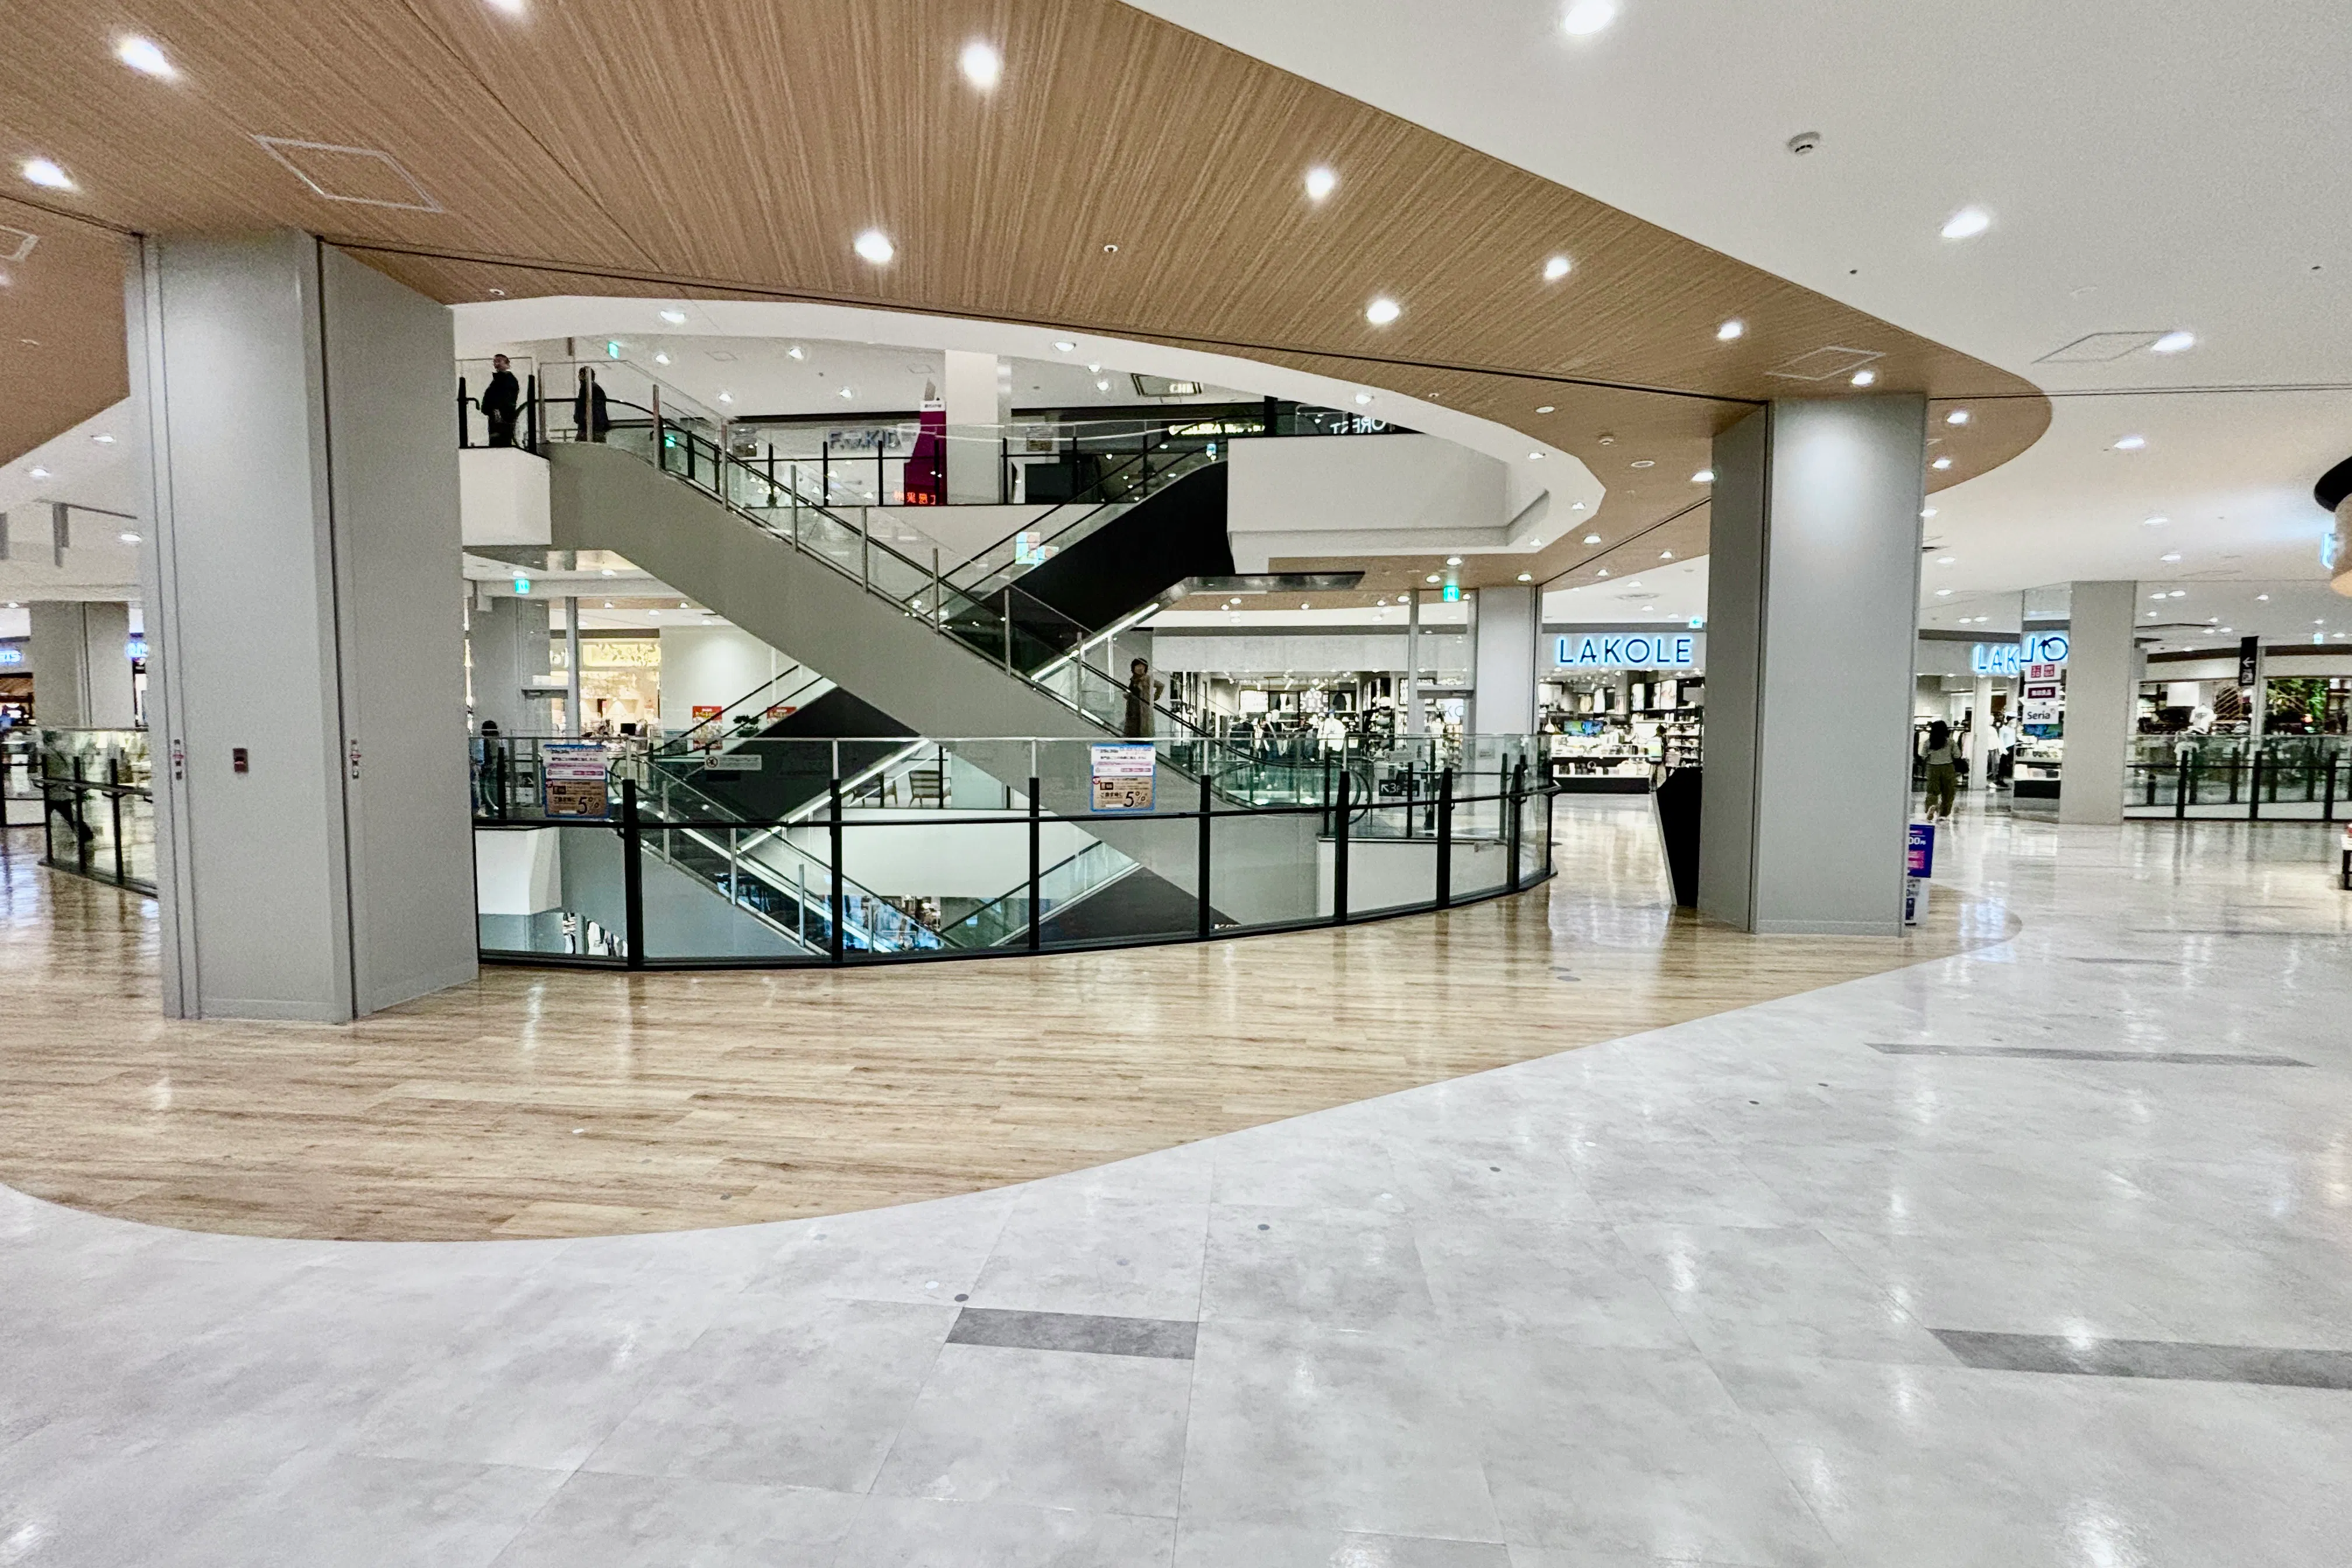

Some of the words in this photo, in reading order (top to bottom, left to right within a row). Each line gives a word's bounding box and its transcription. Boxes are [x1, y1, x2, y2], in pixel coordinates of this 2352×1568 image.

[1559, 639, 1691, 663] LAKOLE
[2027, 710, 2050, 719] Seria
[1124, 791, 1146, 807] 5%
